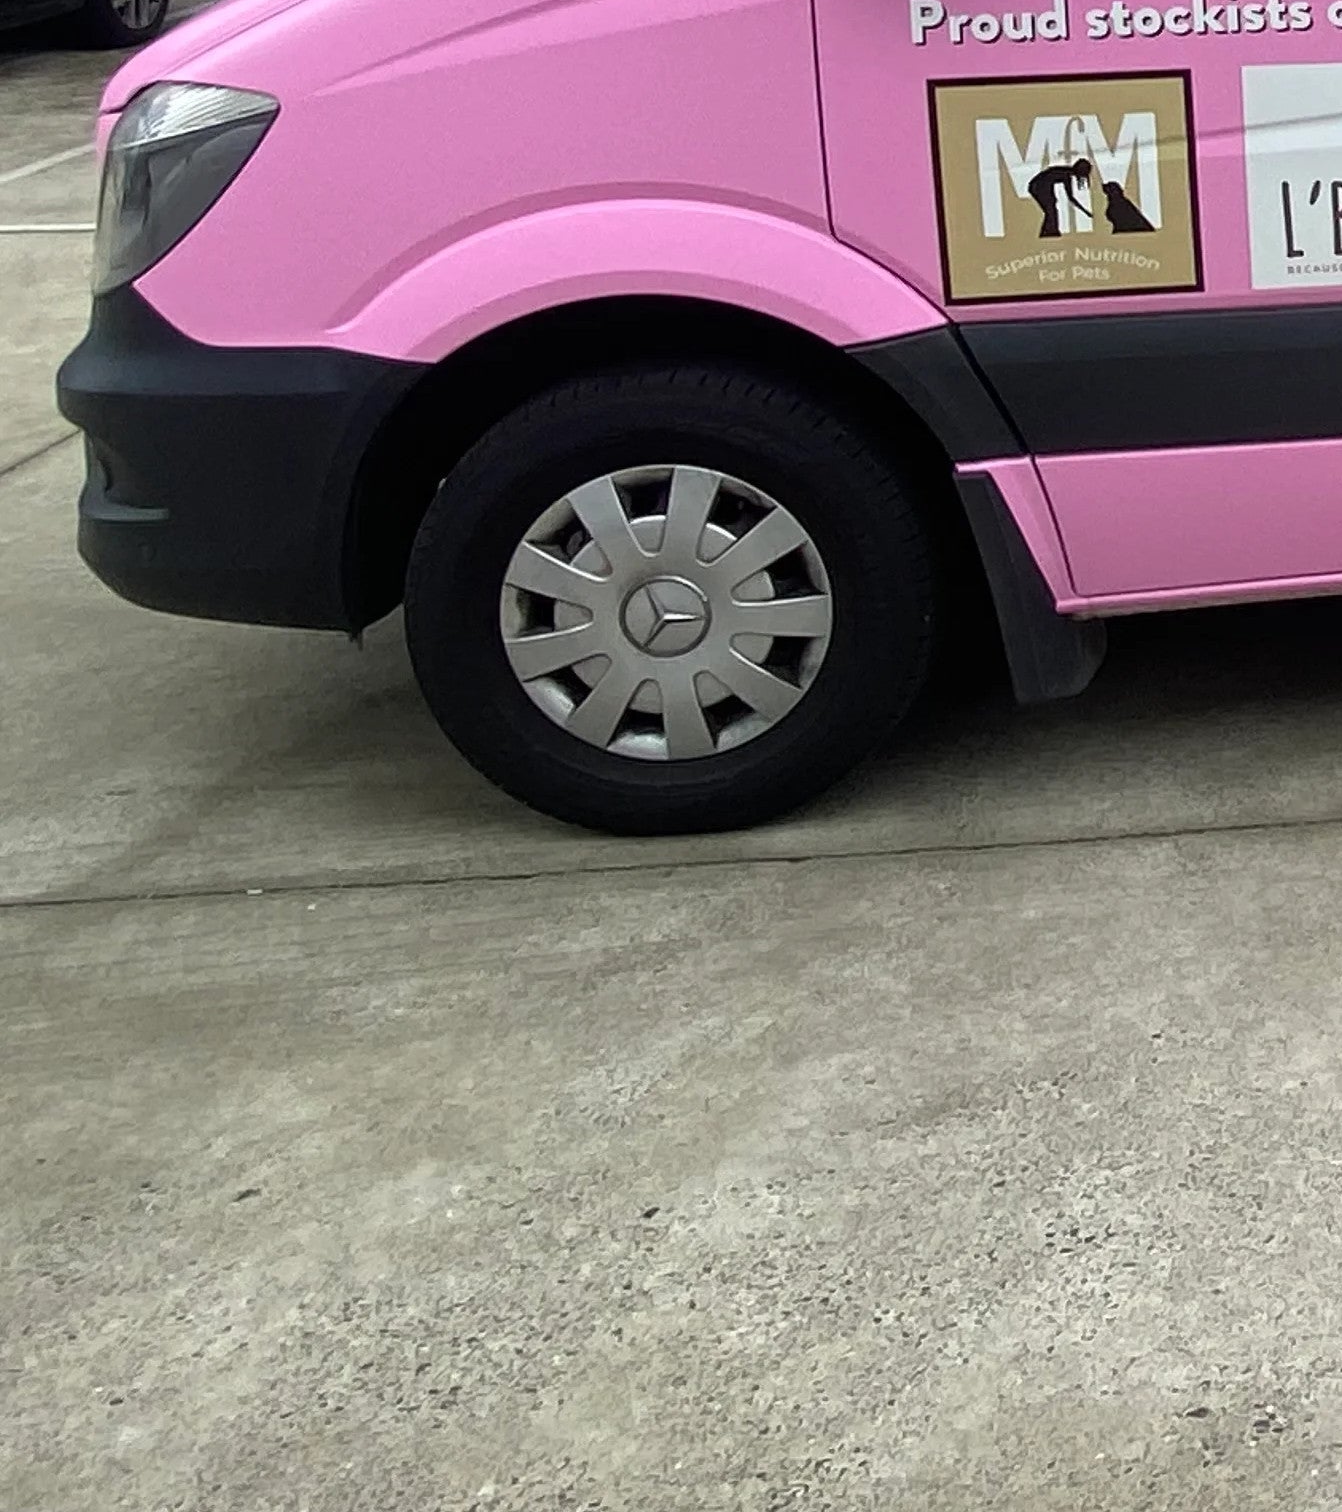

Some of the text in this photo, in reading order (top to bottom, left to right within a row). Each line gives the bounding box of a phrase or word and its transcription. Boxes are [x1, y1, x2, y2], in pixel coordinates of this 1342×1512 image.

[985, 247, 1160, 280] Superior Nutrition
[1039, 265, 1110, 283] For Pets
